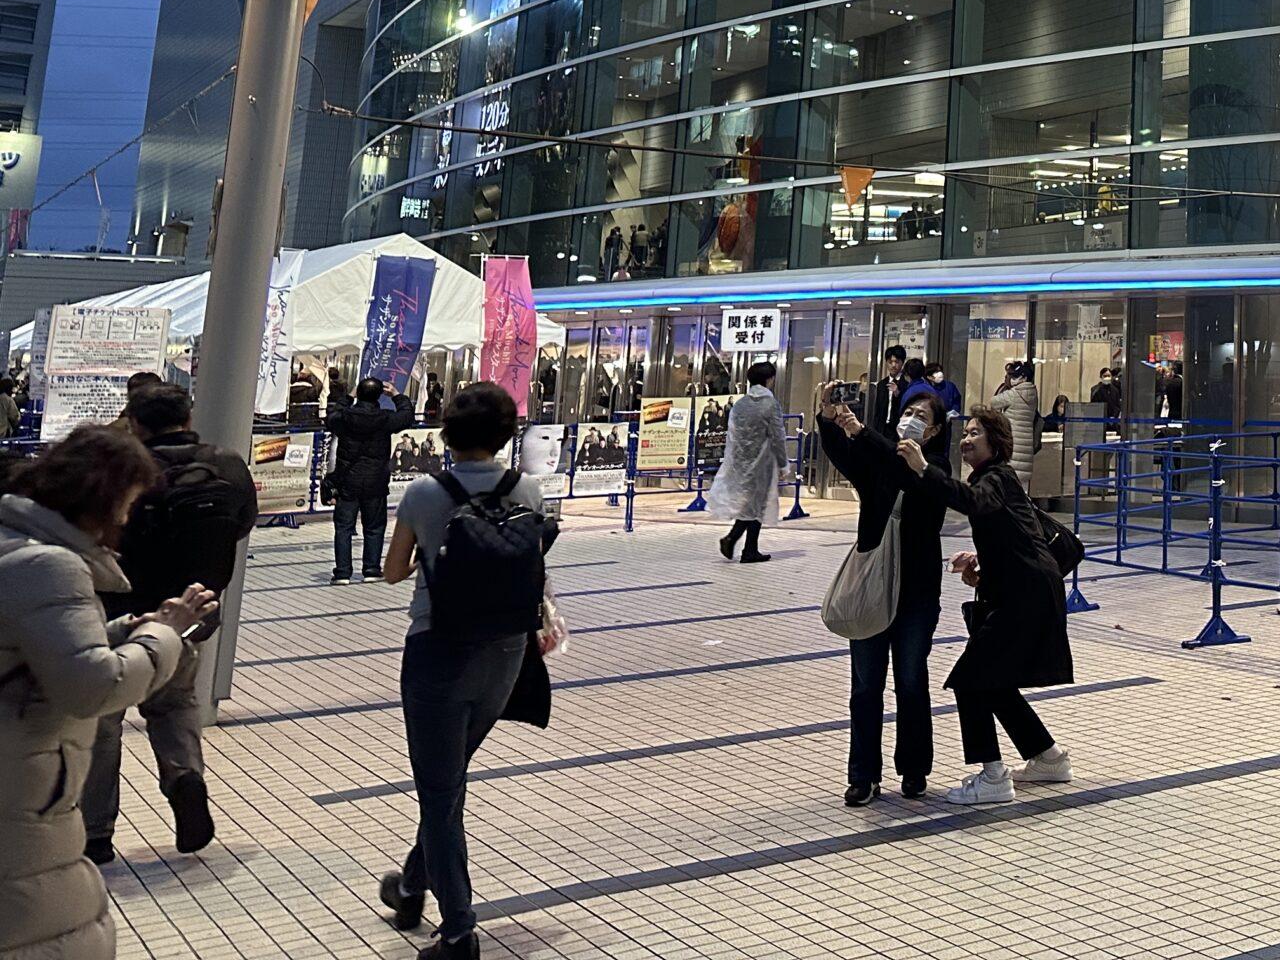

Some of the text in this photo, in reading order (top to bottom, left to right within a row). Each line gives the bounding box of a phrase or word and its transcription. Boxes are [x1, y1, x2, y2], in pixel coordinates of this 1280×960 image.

[389, 314, 399, 329] So
[728, 315, 773, 329] 関係者
[735, 330, 765, 344] 受付
